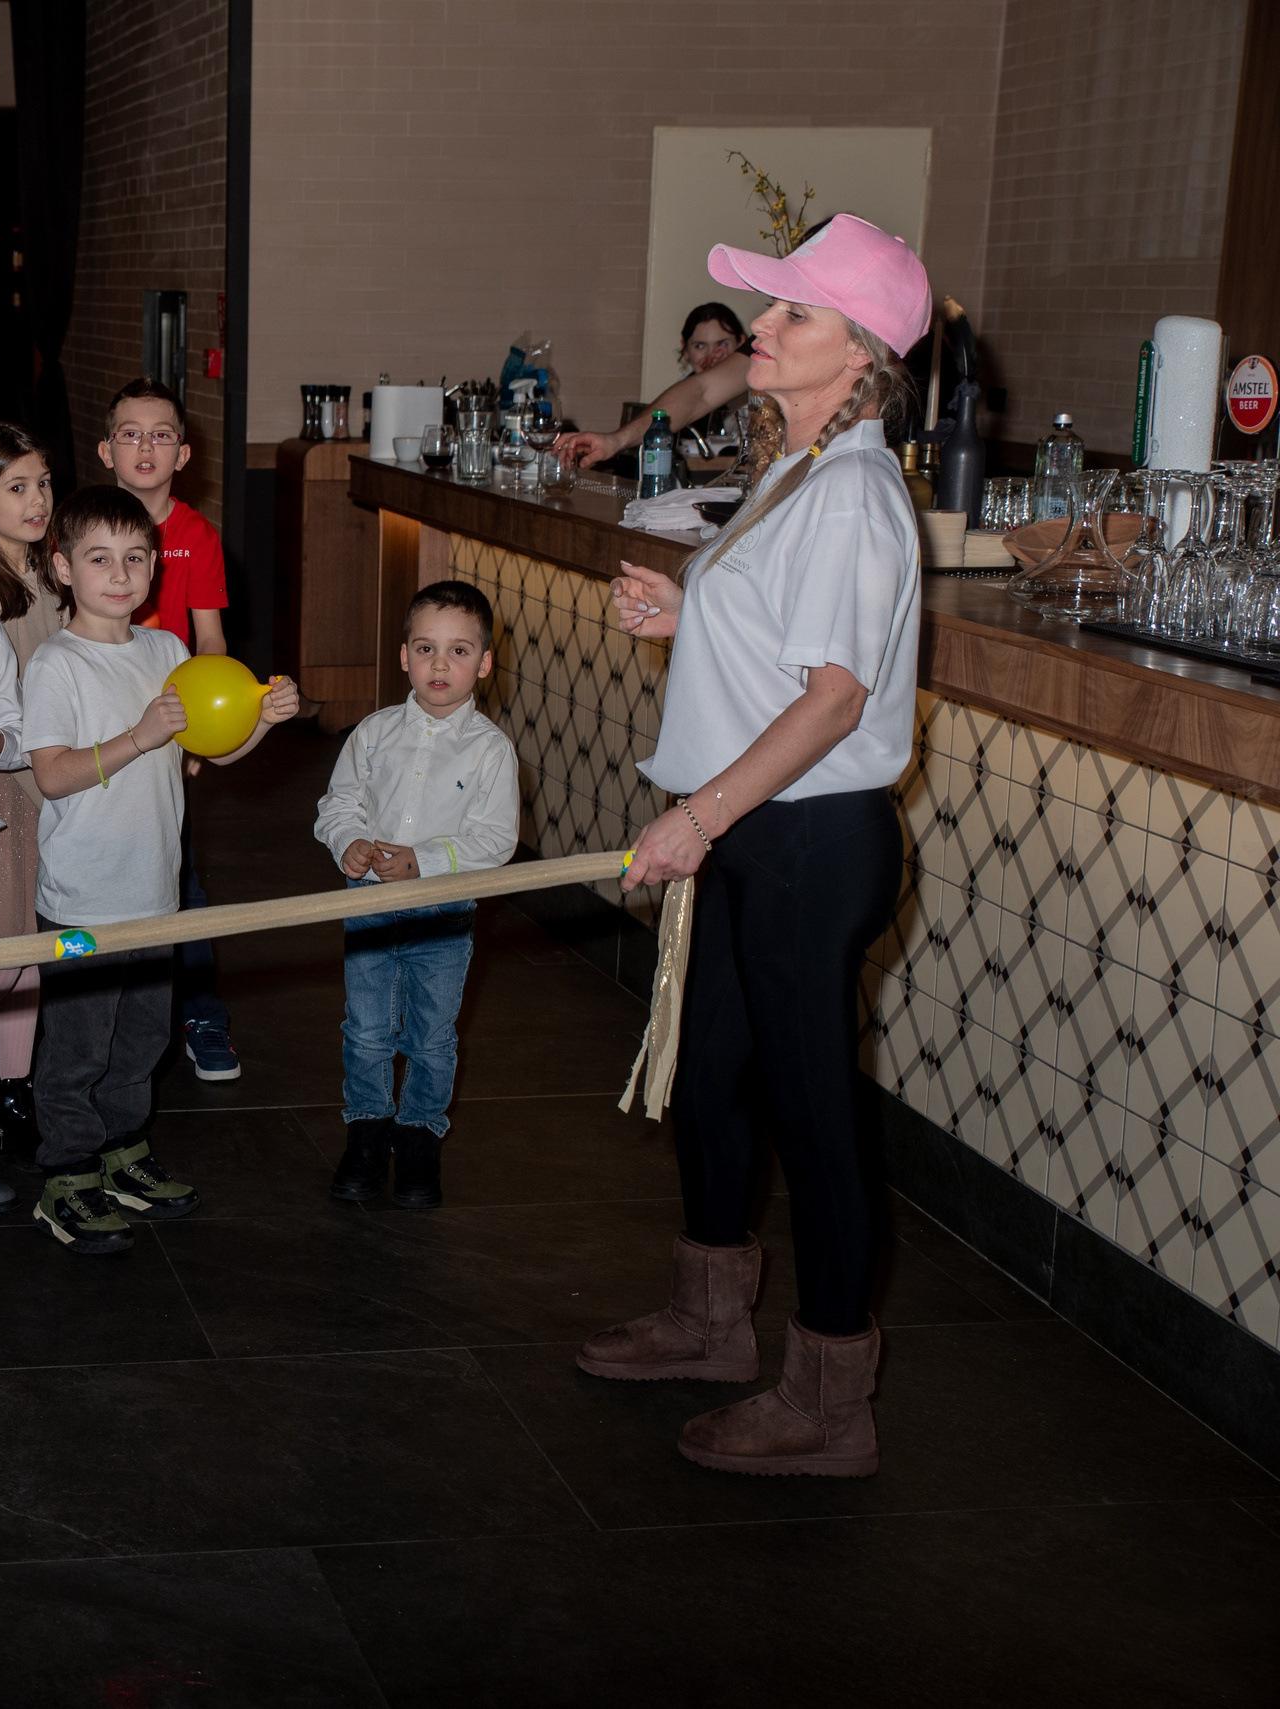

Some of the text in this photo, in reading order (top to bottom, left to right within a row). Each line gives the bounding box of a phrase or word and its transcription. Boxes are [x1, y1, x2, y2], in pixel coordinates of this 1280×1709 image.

[1139, 360, 1147, 397] Heineken
[1232, 382, 1269, 395] AMSTEL
[1239, 400, 1259, 410] BEER
[727, 554, 752, 572] NANNY
